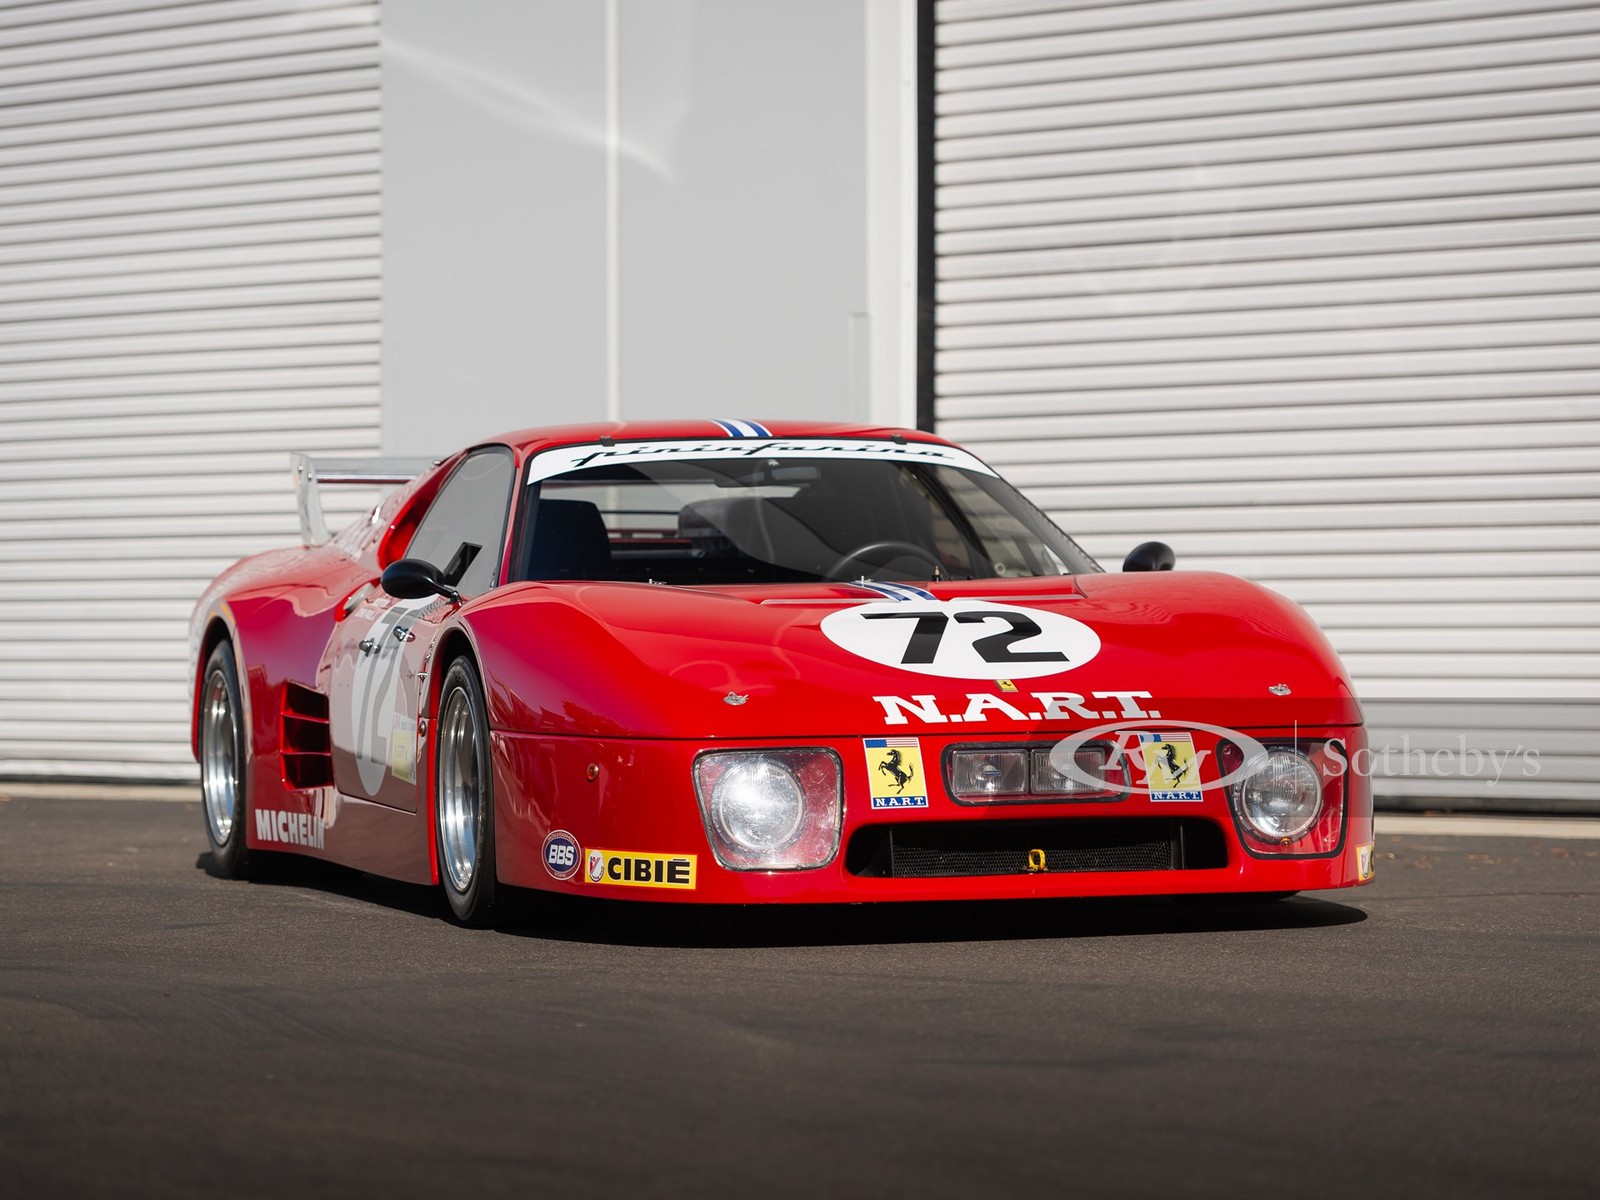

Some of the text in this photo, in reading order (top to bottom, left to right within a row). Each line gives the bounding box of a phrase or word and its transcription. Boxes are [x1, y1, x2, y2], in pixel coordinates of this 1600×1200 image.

[571, 442, 954, 467] pininfarina
[860, 611, 1070, 664] 72
[872, 691, 1162, 725] N.A.R.T.
[255, 808, 325, 850] MICHELIN
[548, 844, 575, 866] BBS
